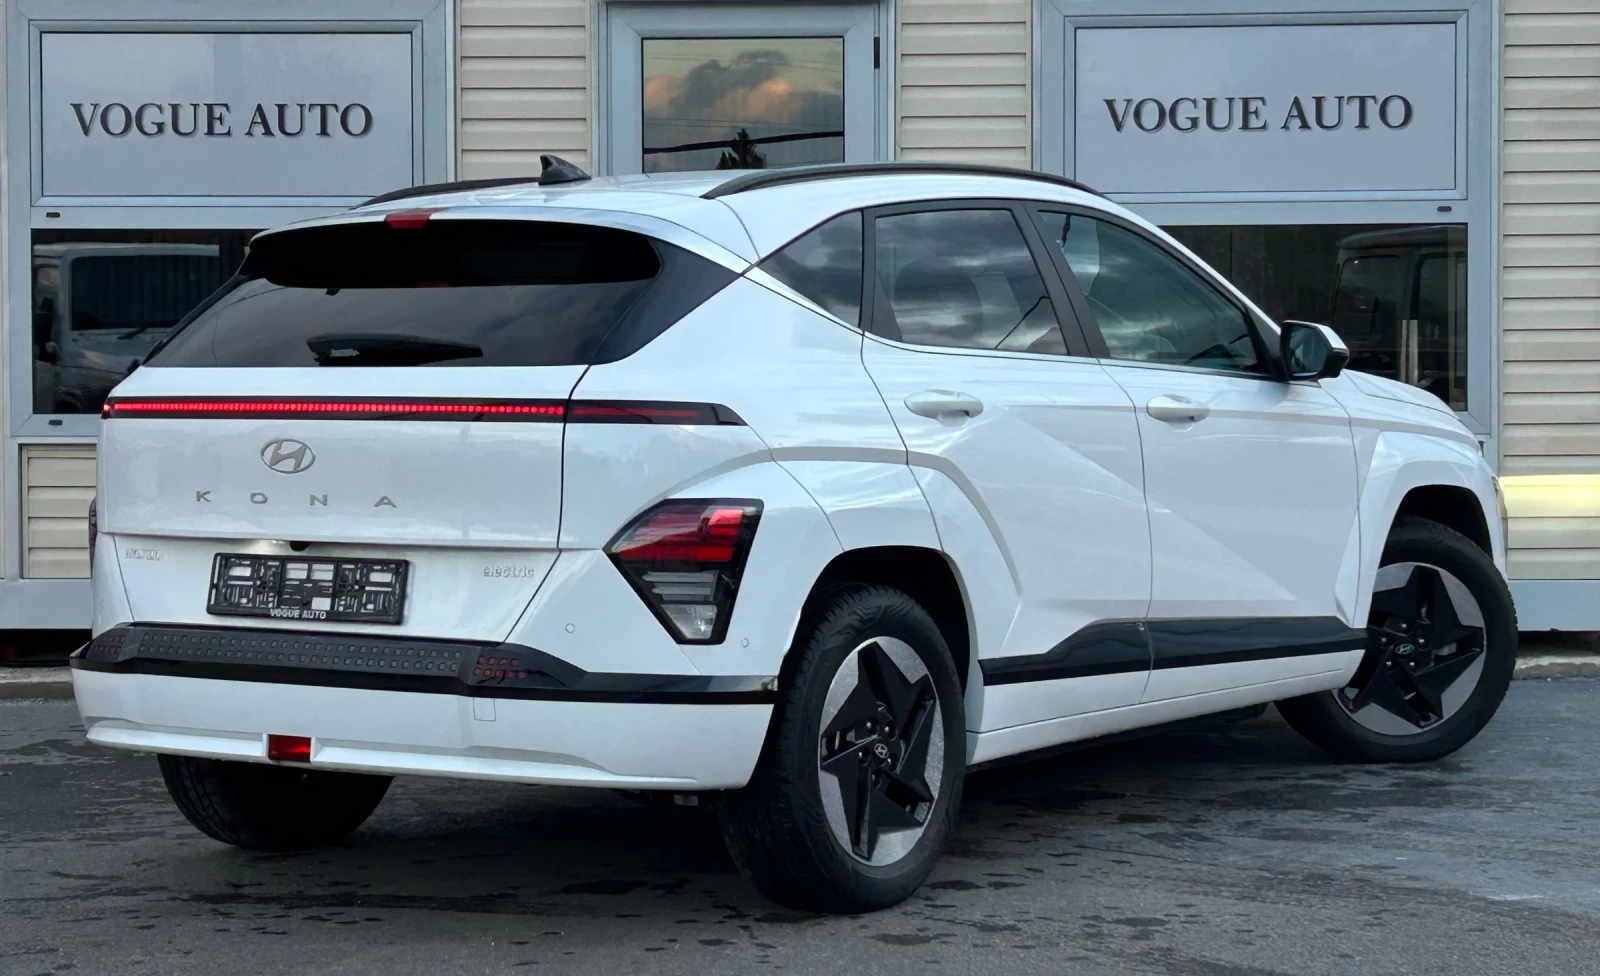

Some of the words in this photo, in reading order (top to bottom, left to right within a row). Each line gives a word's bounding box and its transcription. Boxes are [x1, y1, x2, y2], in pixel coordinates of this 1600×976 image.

[70, 102, 232, 138] VOGUE
[244, 102, 374, 138] AUTO
[1103, 96, 1268, 132] VOGUE
[1280, 94, 1414, 131] AUTO
[196, 490, 397, 508] KONA
[483, 564, 535, 578] electric
[269, 608, 301, 618] VOGUE
[302, 610, 327, 620] AUTO
